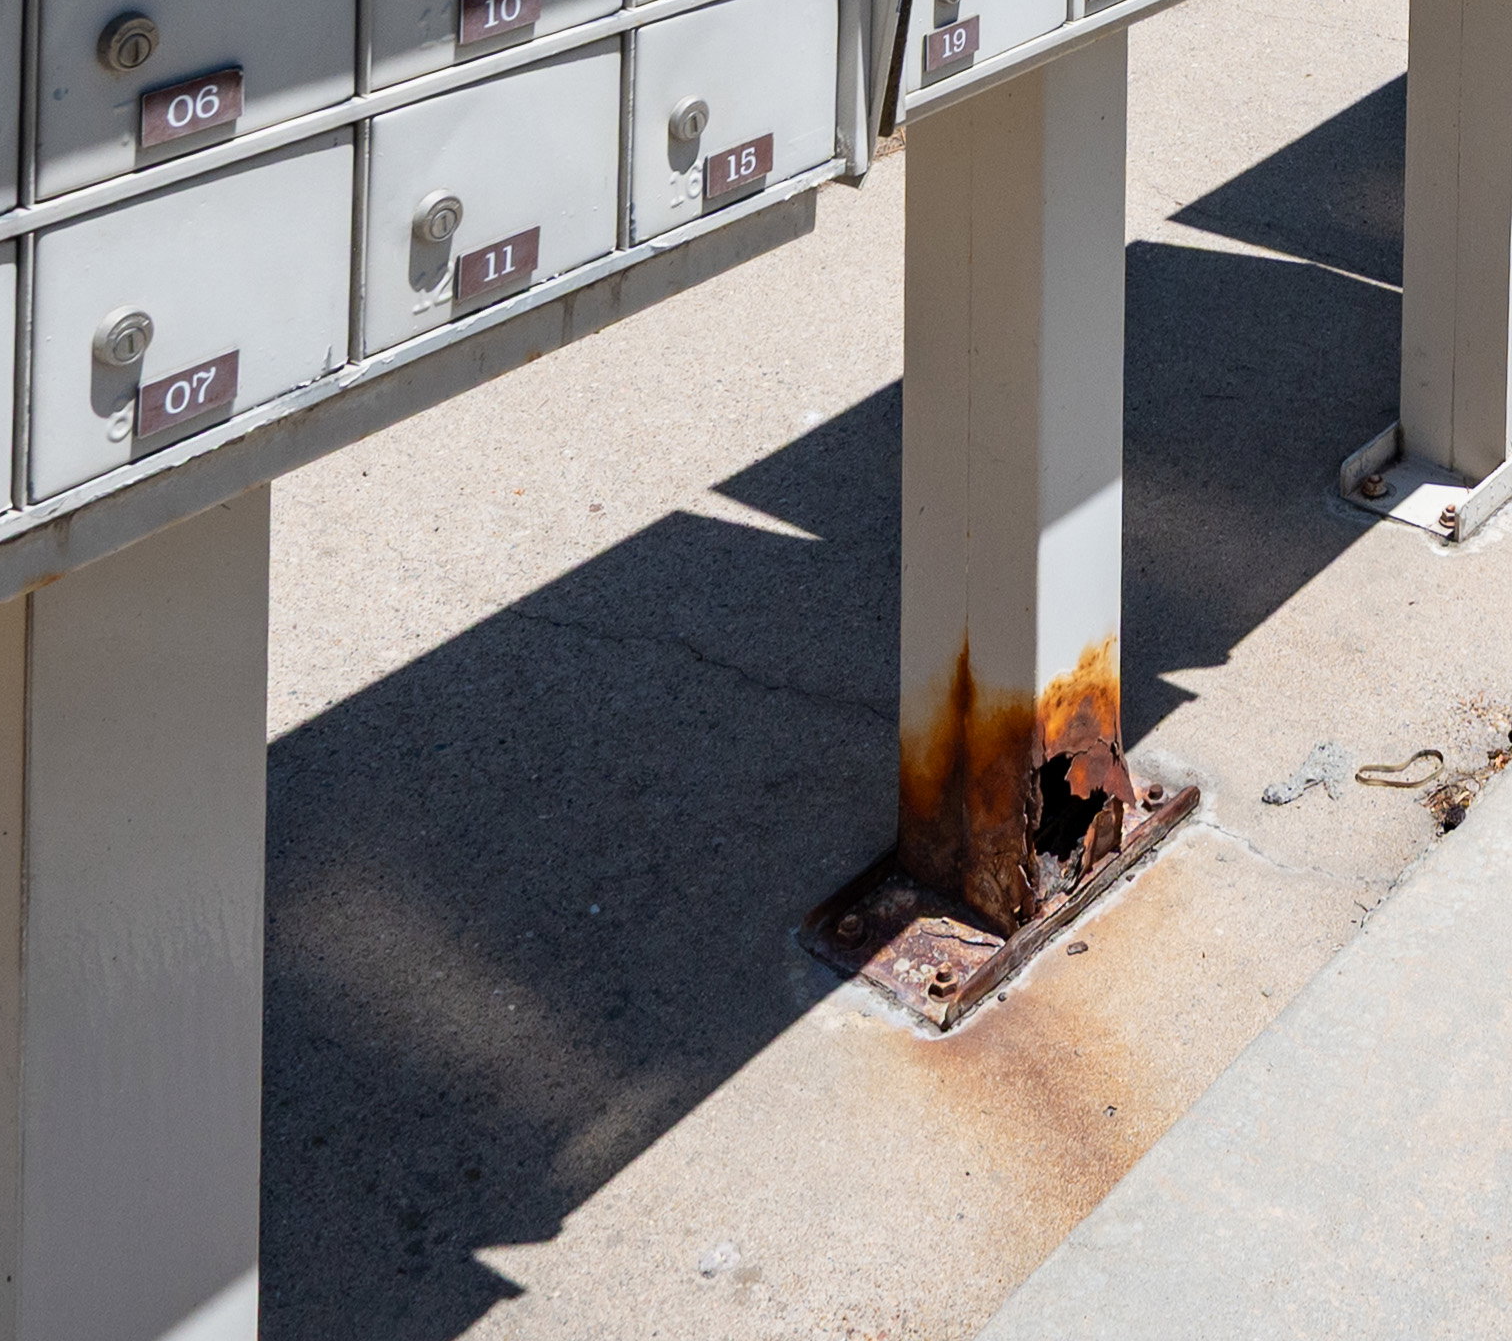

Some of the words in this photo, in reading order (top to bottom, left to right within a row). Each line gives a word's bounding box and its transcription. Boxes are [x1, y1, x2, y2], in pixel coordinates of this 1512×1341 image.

[942, 34, 967, 61] 19
[166, 85, 221, 129] 06
[726, 147, 758, 183] 15
[485, 245, 518, 282] 11
[164, 365, 217, 415] 07
